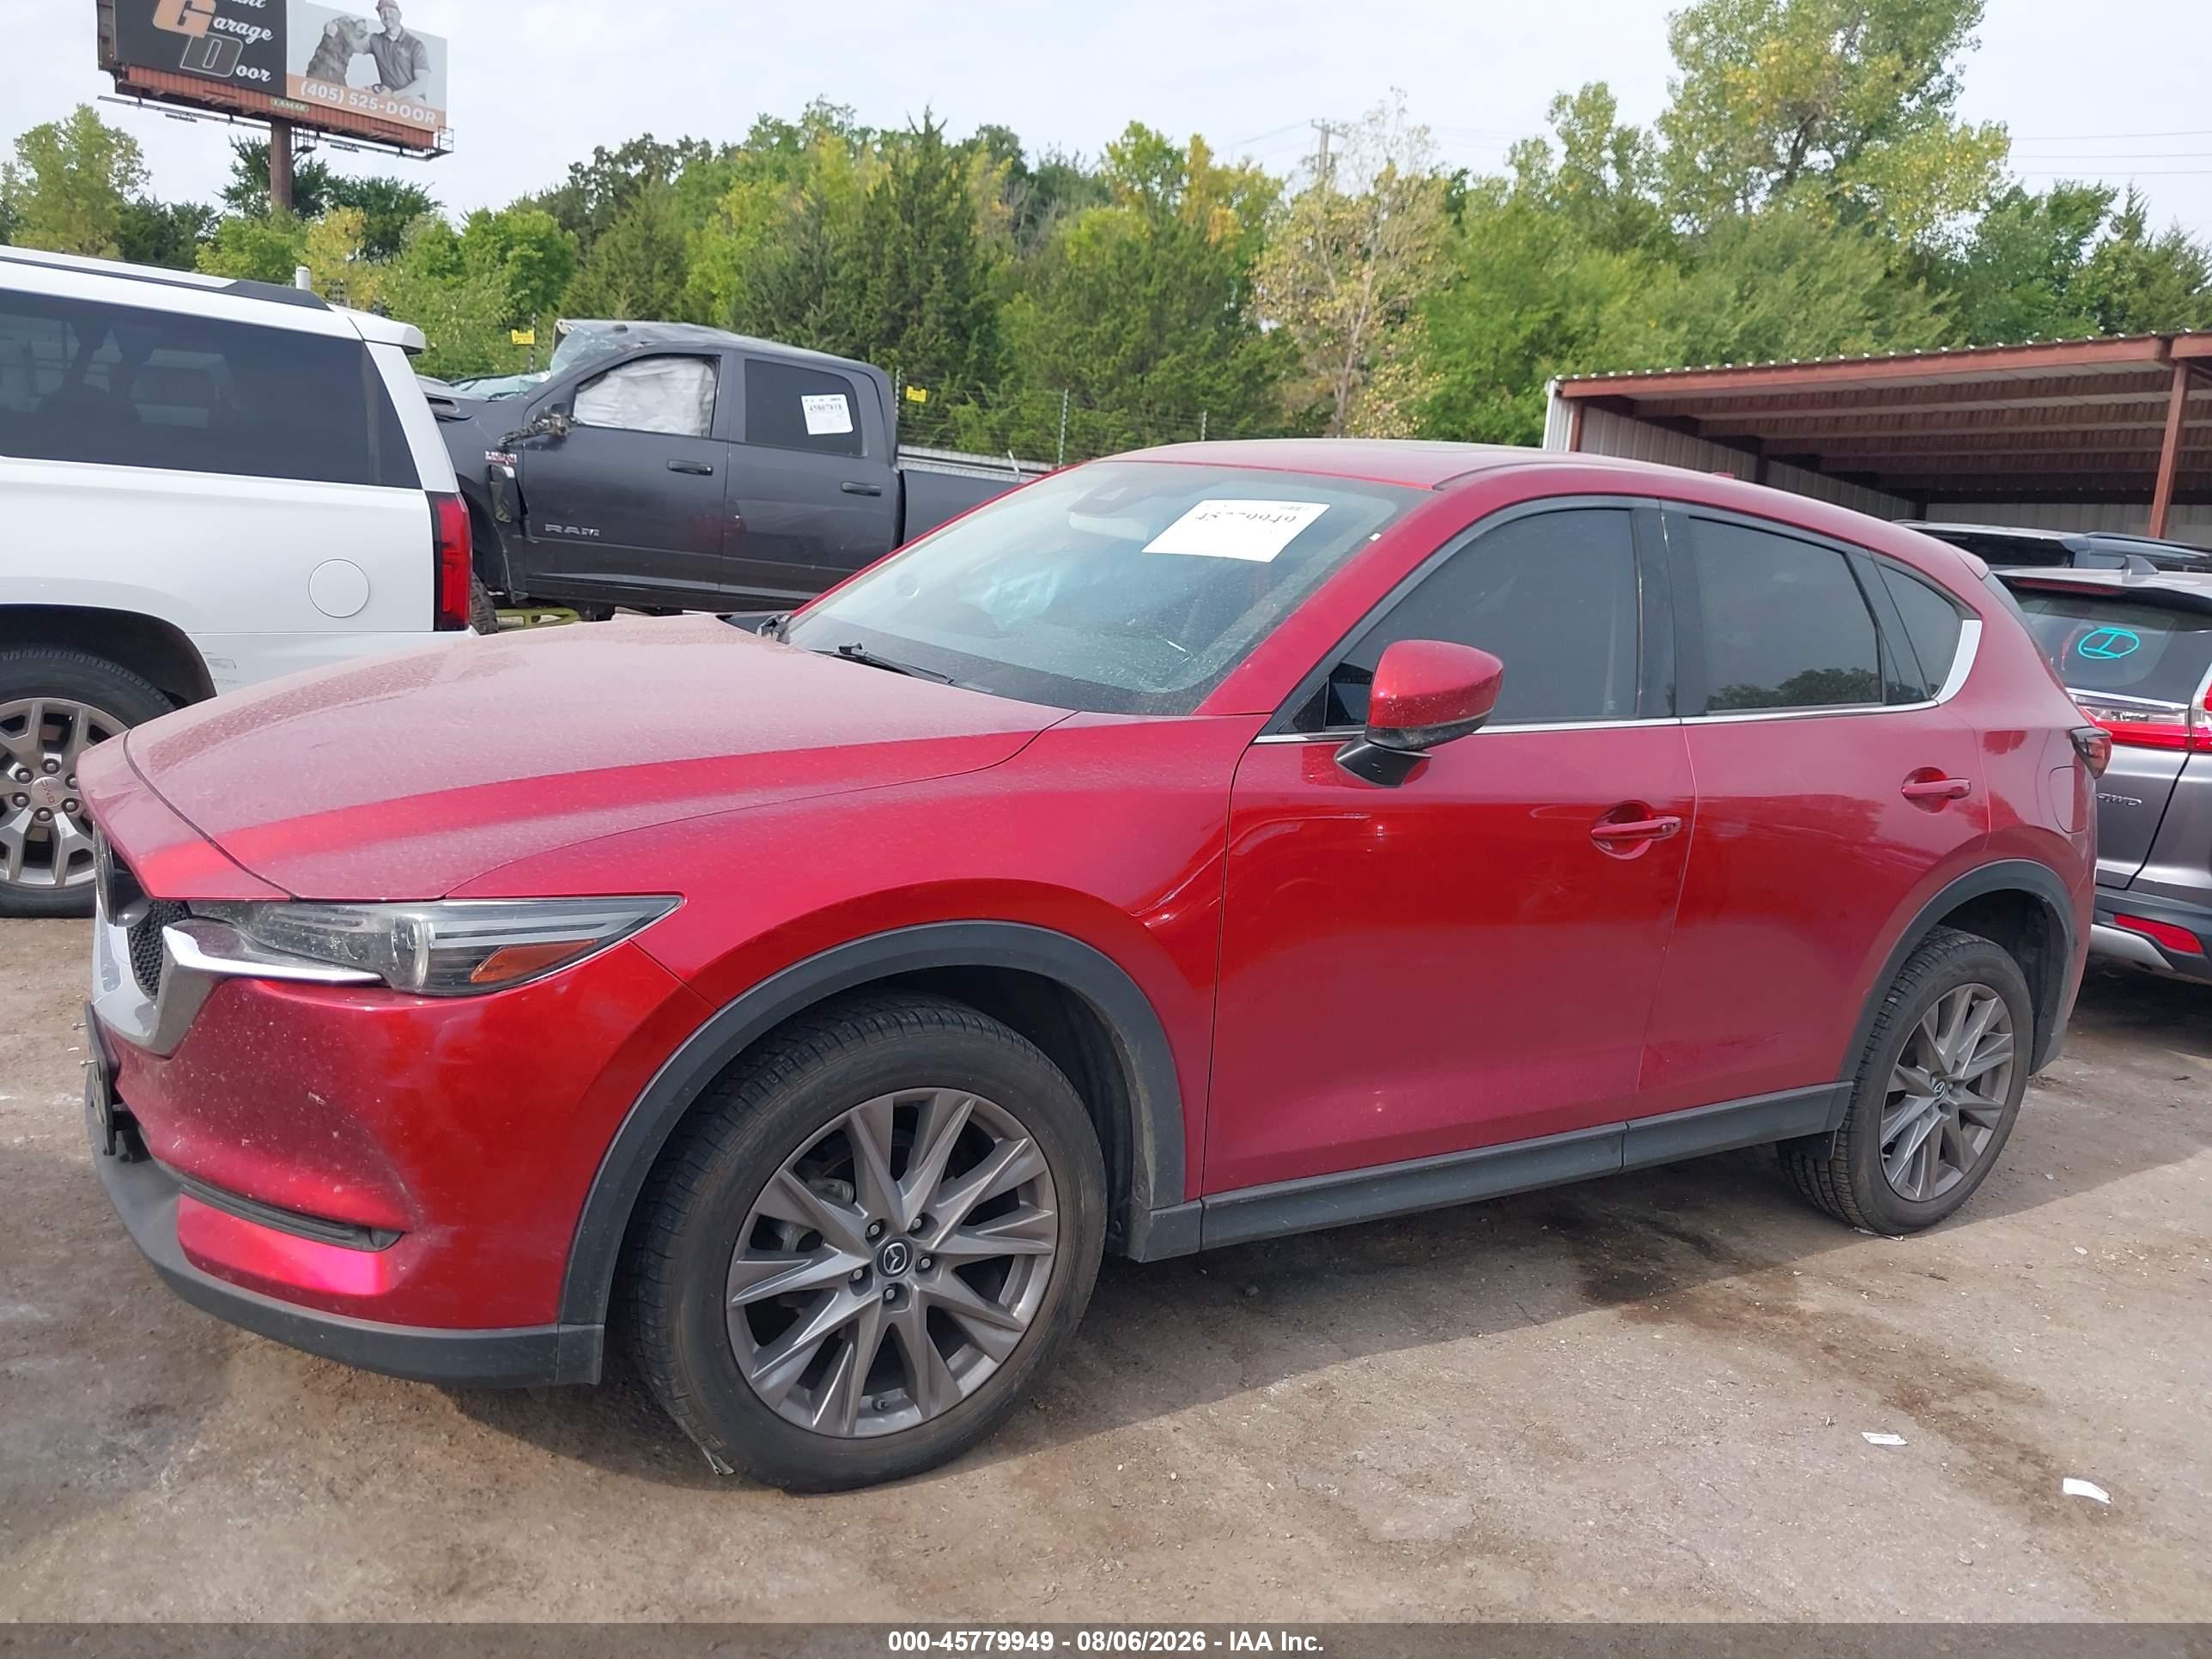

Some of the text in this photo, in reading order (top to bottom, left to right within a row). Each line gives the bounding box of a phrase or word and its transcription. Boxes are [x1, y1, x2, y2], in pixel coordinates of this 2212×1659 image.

[153, 0, 273, 44] Garage
[179, 30, 271, 82] Door
[301, 81, 436, 125] (405) 525-DOOR
[544, 523, 600, 537] RAM
[40, 780, 56, 804] GMC
